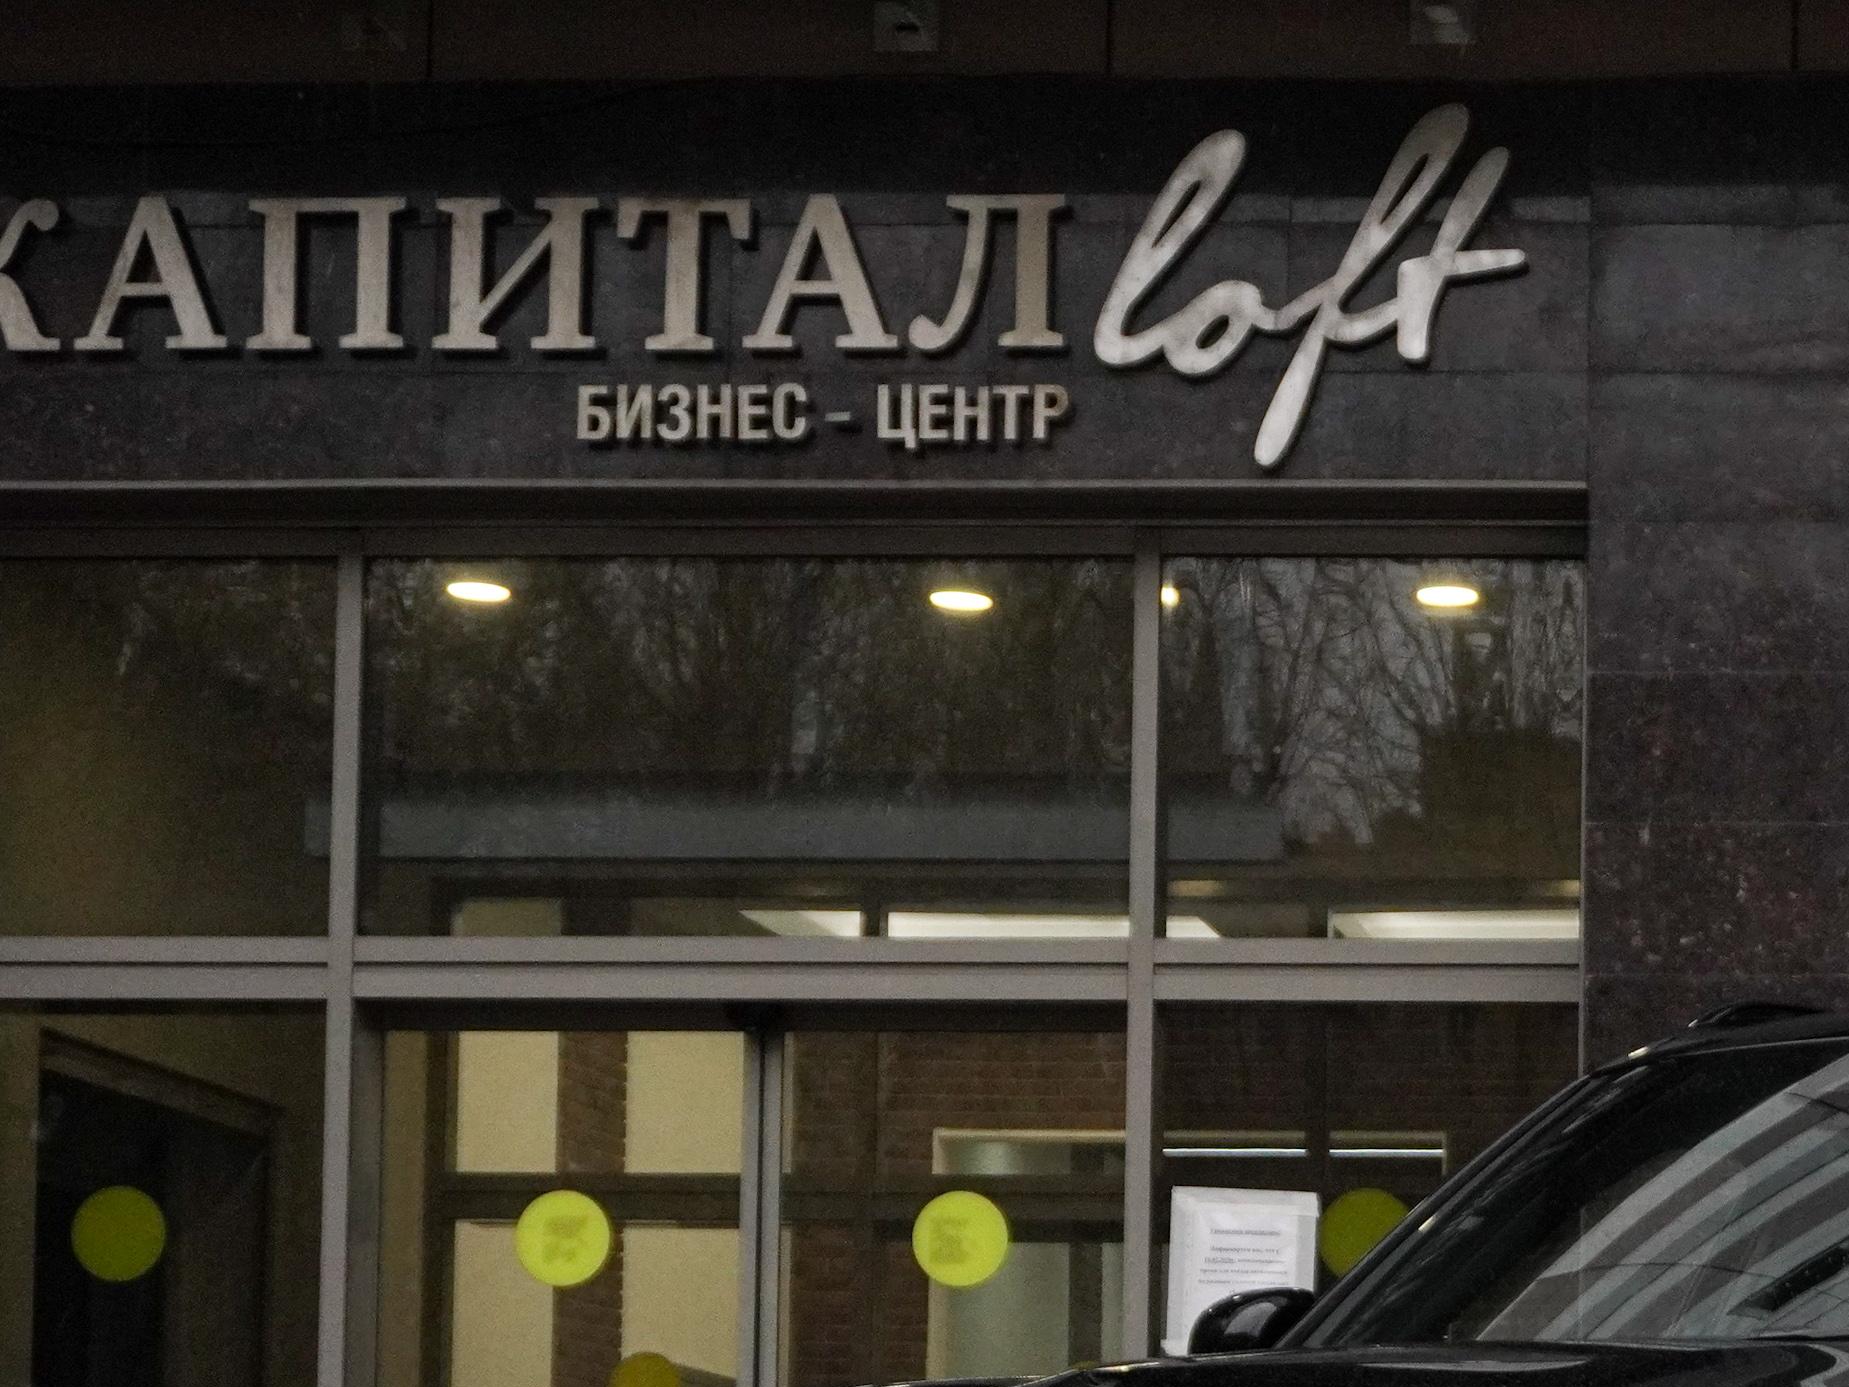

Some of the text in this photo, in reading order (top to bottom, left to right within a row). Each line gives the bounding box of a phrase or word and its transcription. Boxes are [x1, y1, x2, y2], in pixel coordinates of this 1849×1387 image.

[1094, 103, 1527, 467] loft
[576, 382, 808, 440] БИЗНЕС
[876, 383, 1070, 449] ЦЕНТР
